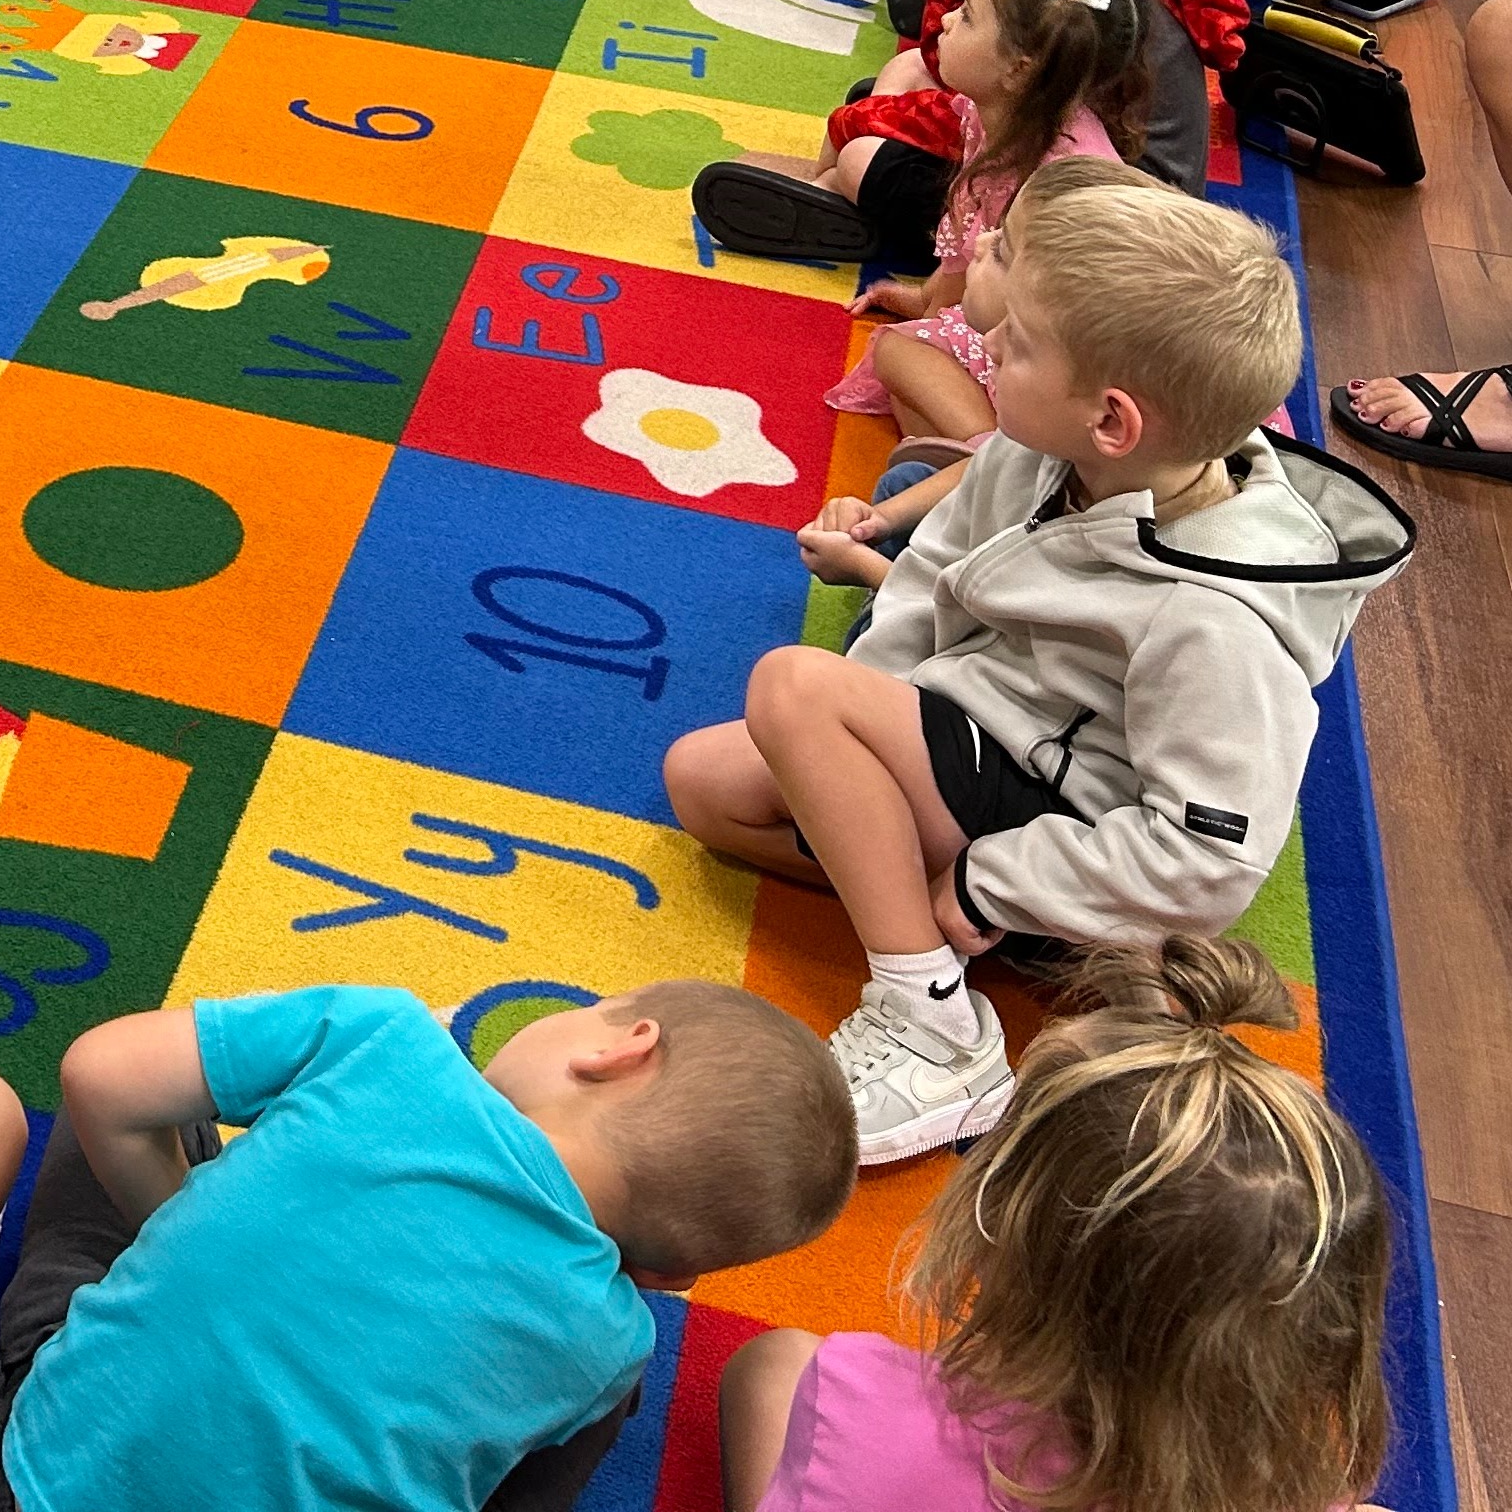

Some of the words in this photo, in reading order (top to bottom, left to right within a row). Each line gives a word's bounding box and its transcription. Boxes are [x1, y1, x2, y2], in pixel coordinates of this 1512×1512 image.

[600, 19, 721, 81] Ii
[288, 98, 435, 143] 6
[241, 300, 414, 387] Vv
[470, 261, 624, 369] Ee
[462, 564, 673, 701] 10
[267, 811, 662, 943] Yy
